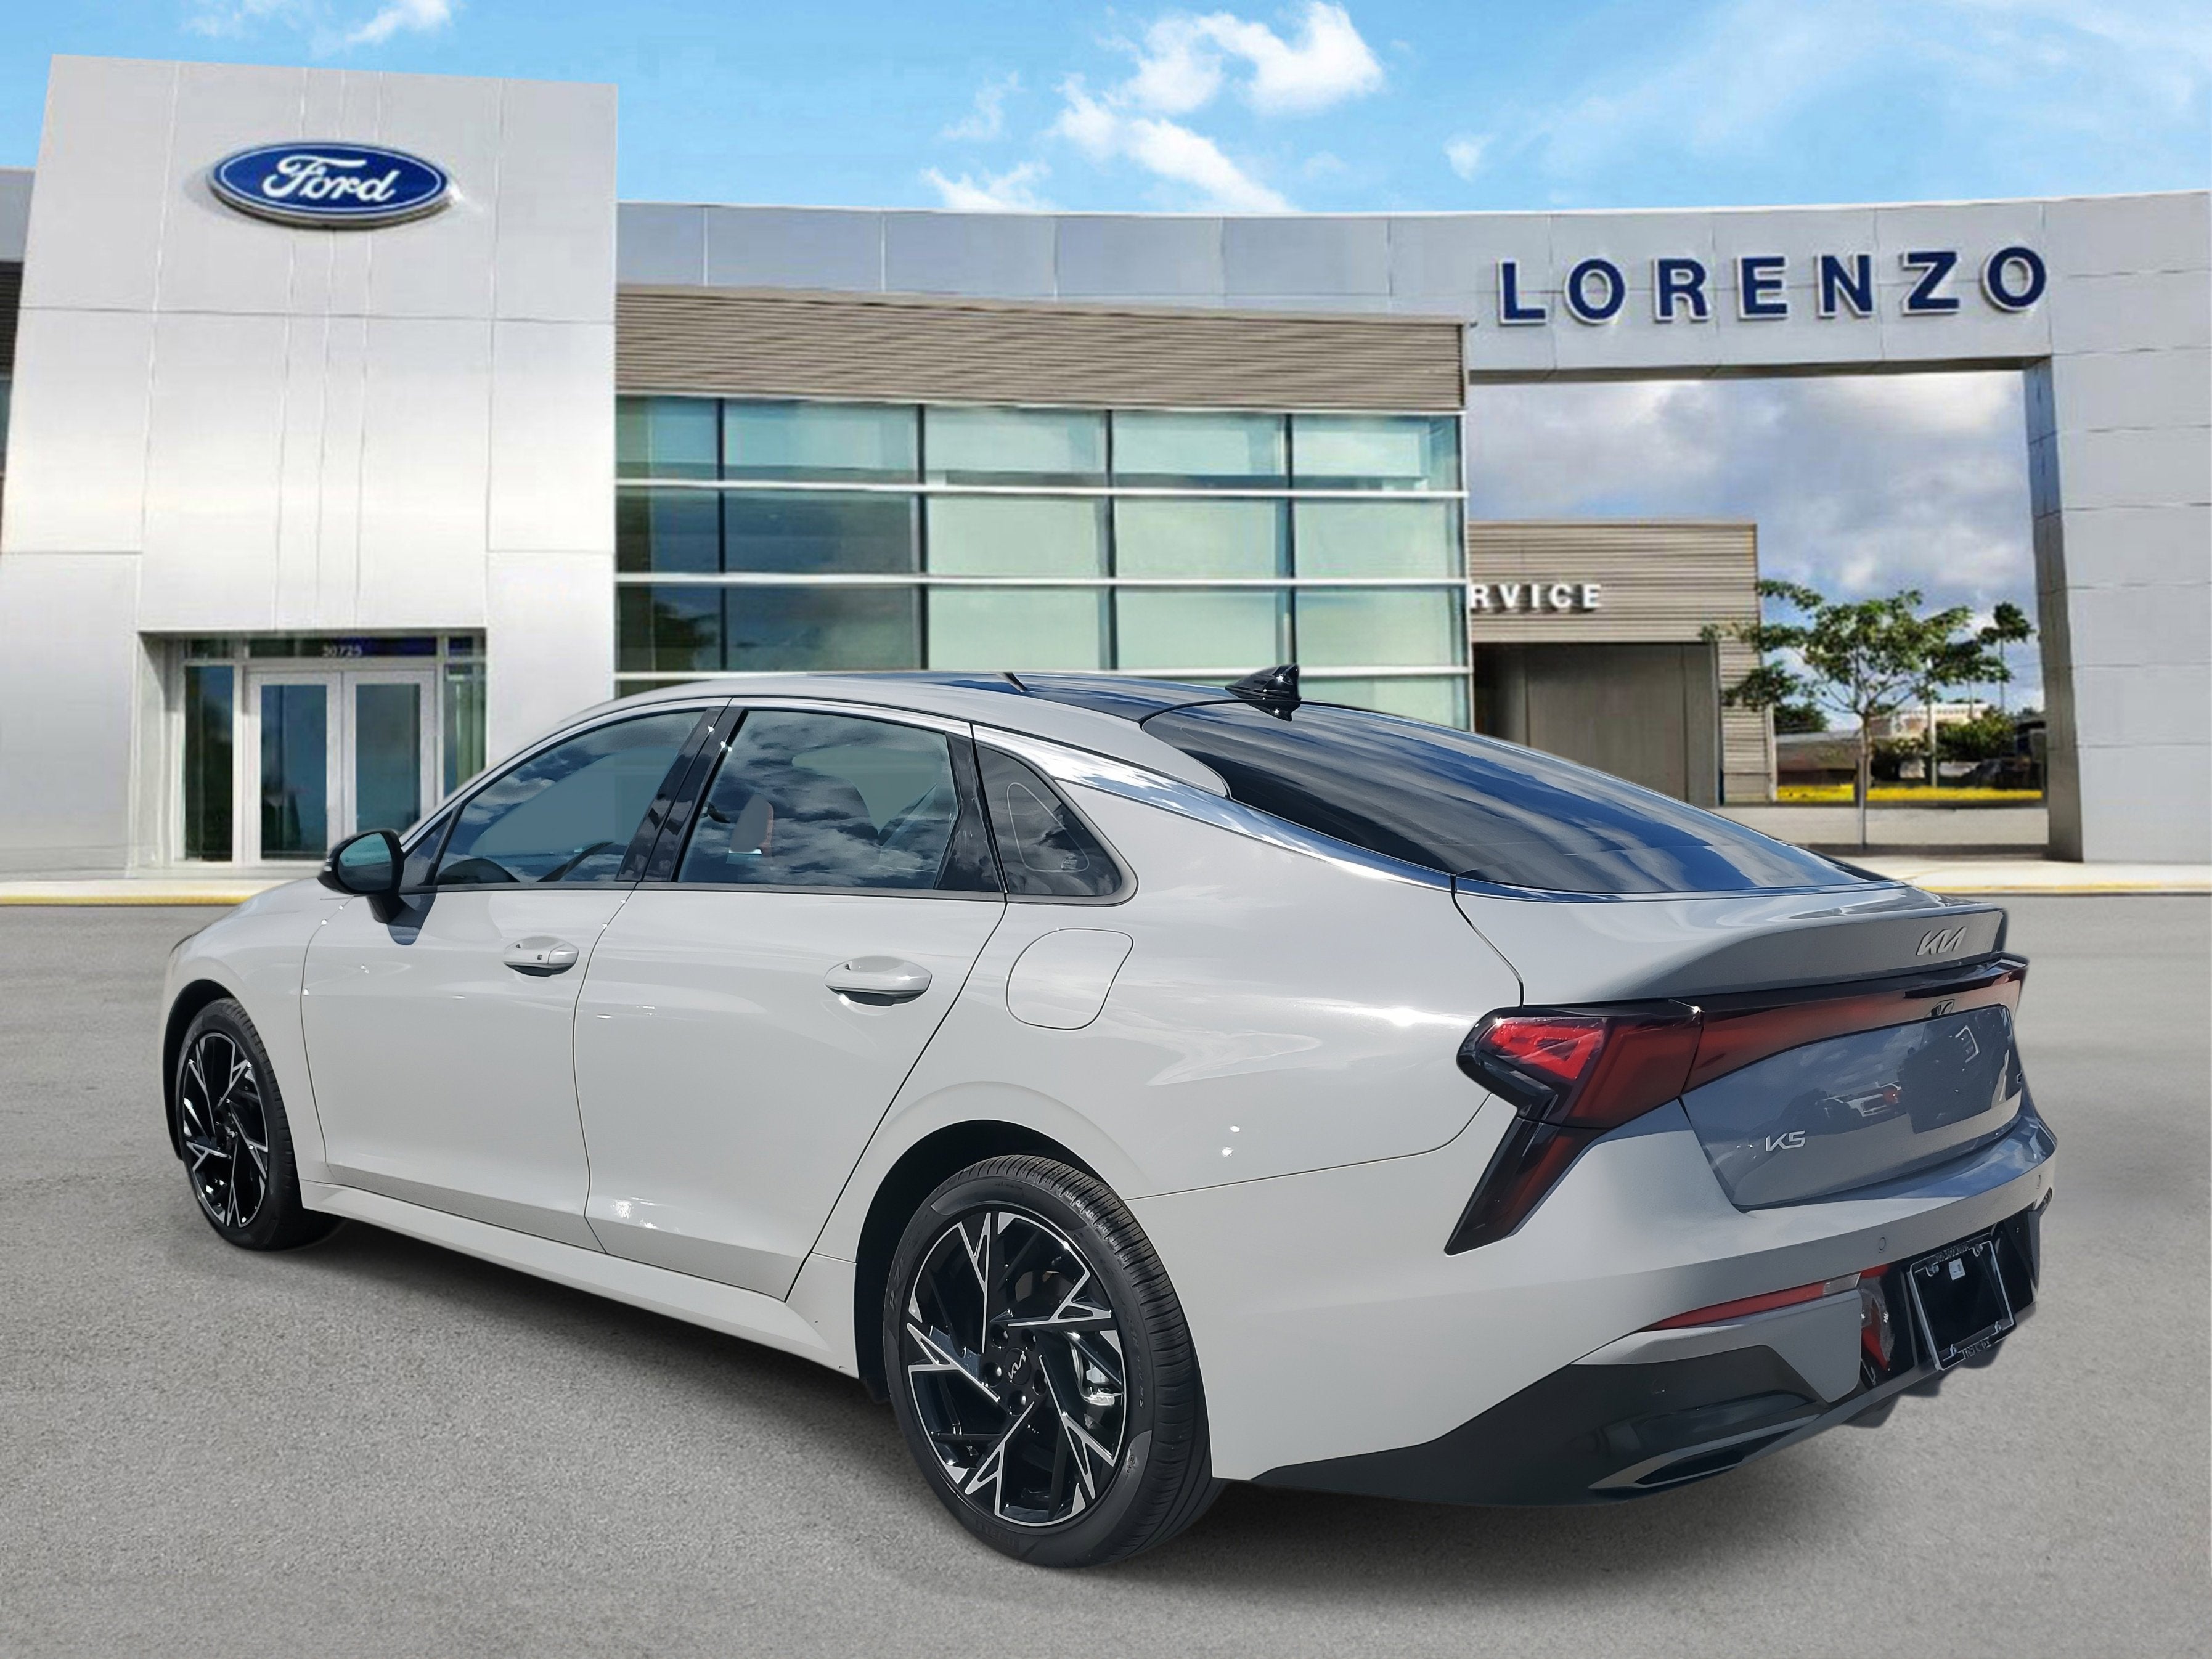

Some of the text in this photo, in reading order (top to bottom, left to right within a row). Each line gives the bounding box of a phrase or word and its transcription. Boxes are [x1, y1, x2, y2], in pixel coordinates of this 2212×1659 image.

[263, 155, 401, 202] Ford
[1498, 246, 2047, 325] LORENZO
[1765, 1130, 1805, 1152] K5
